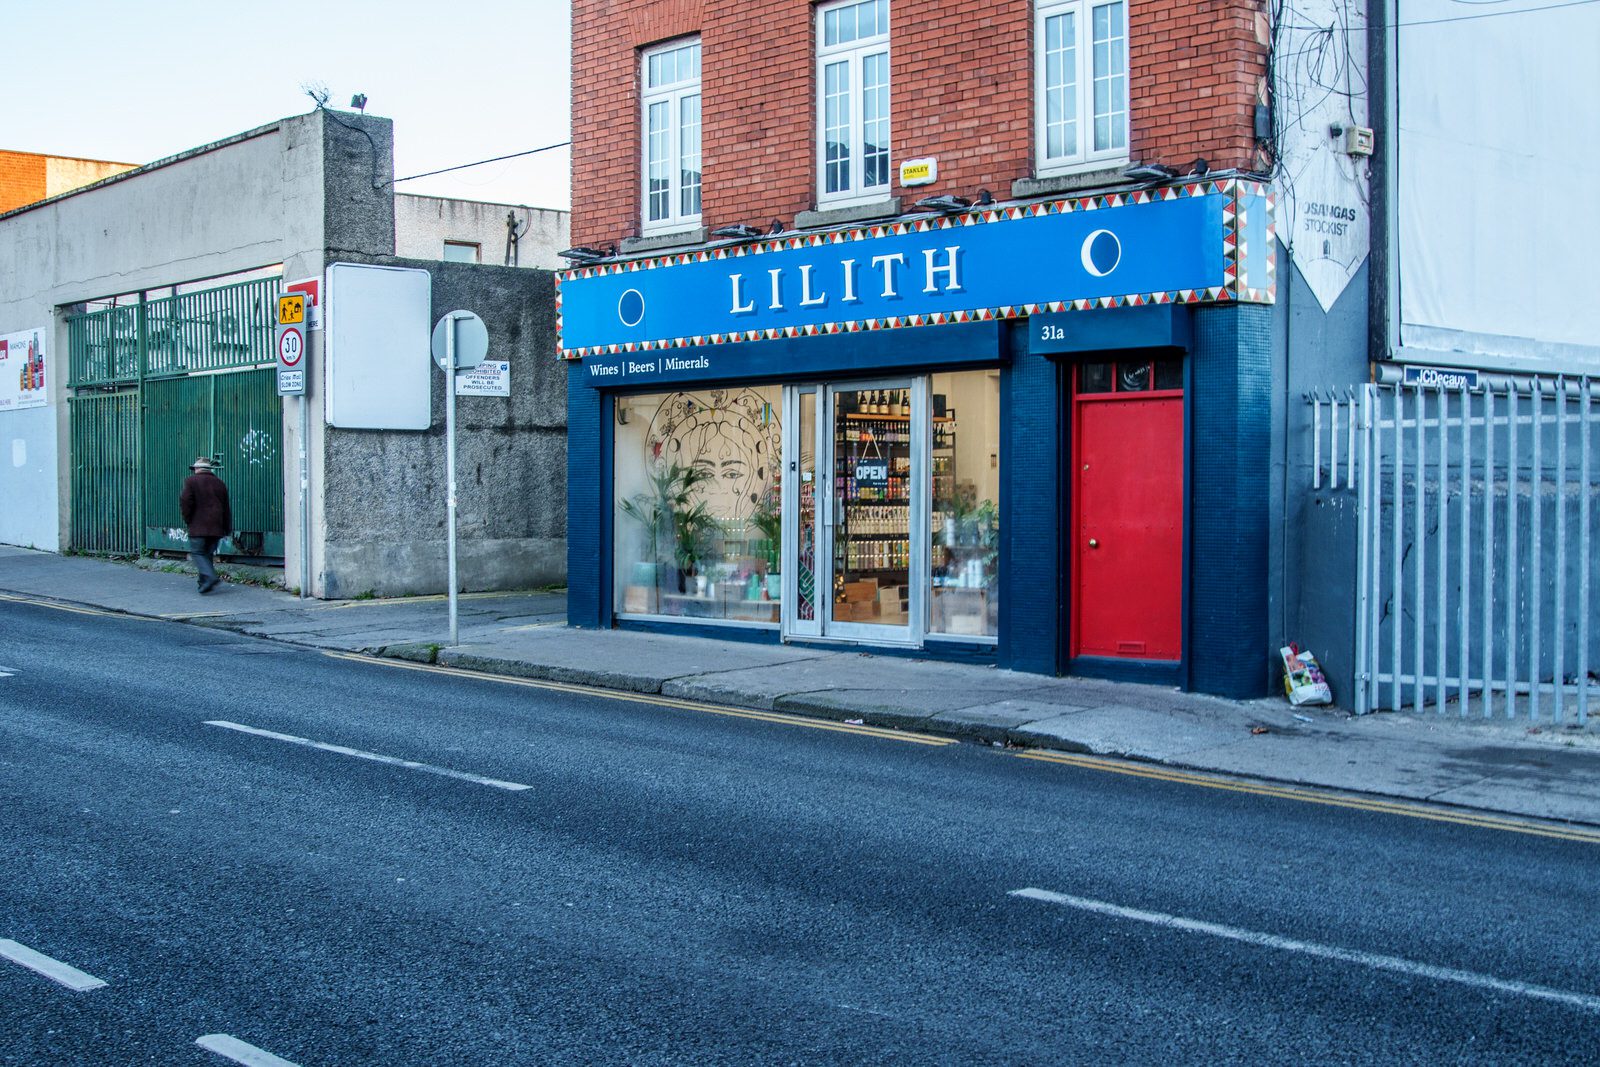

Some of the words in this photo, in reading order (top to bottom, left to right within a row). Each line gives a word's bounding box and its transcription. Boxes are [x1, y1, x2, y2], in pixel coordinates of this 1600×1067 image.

[903, 166, 929, 175] STANLEY
[1304, 218, 1348, 237] STOCKIST
[728, 245, 962, 314] LILITH
[1041, 325, 1065, 341] 31a
[285, 337, 297, 353] 30
[589, 364, 619, 377] Wines
[628, 361, 655, 374] Beers
[665, 355, 709, 371] Minerals
[1416, 368, 1467, 386] JCDecaux
[855, 466, 888, 480] OPEN
